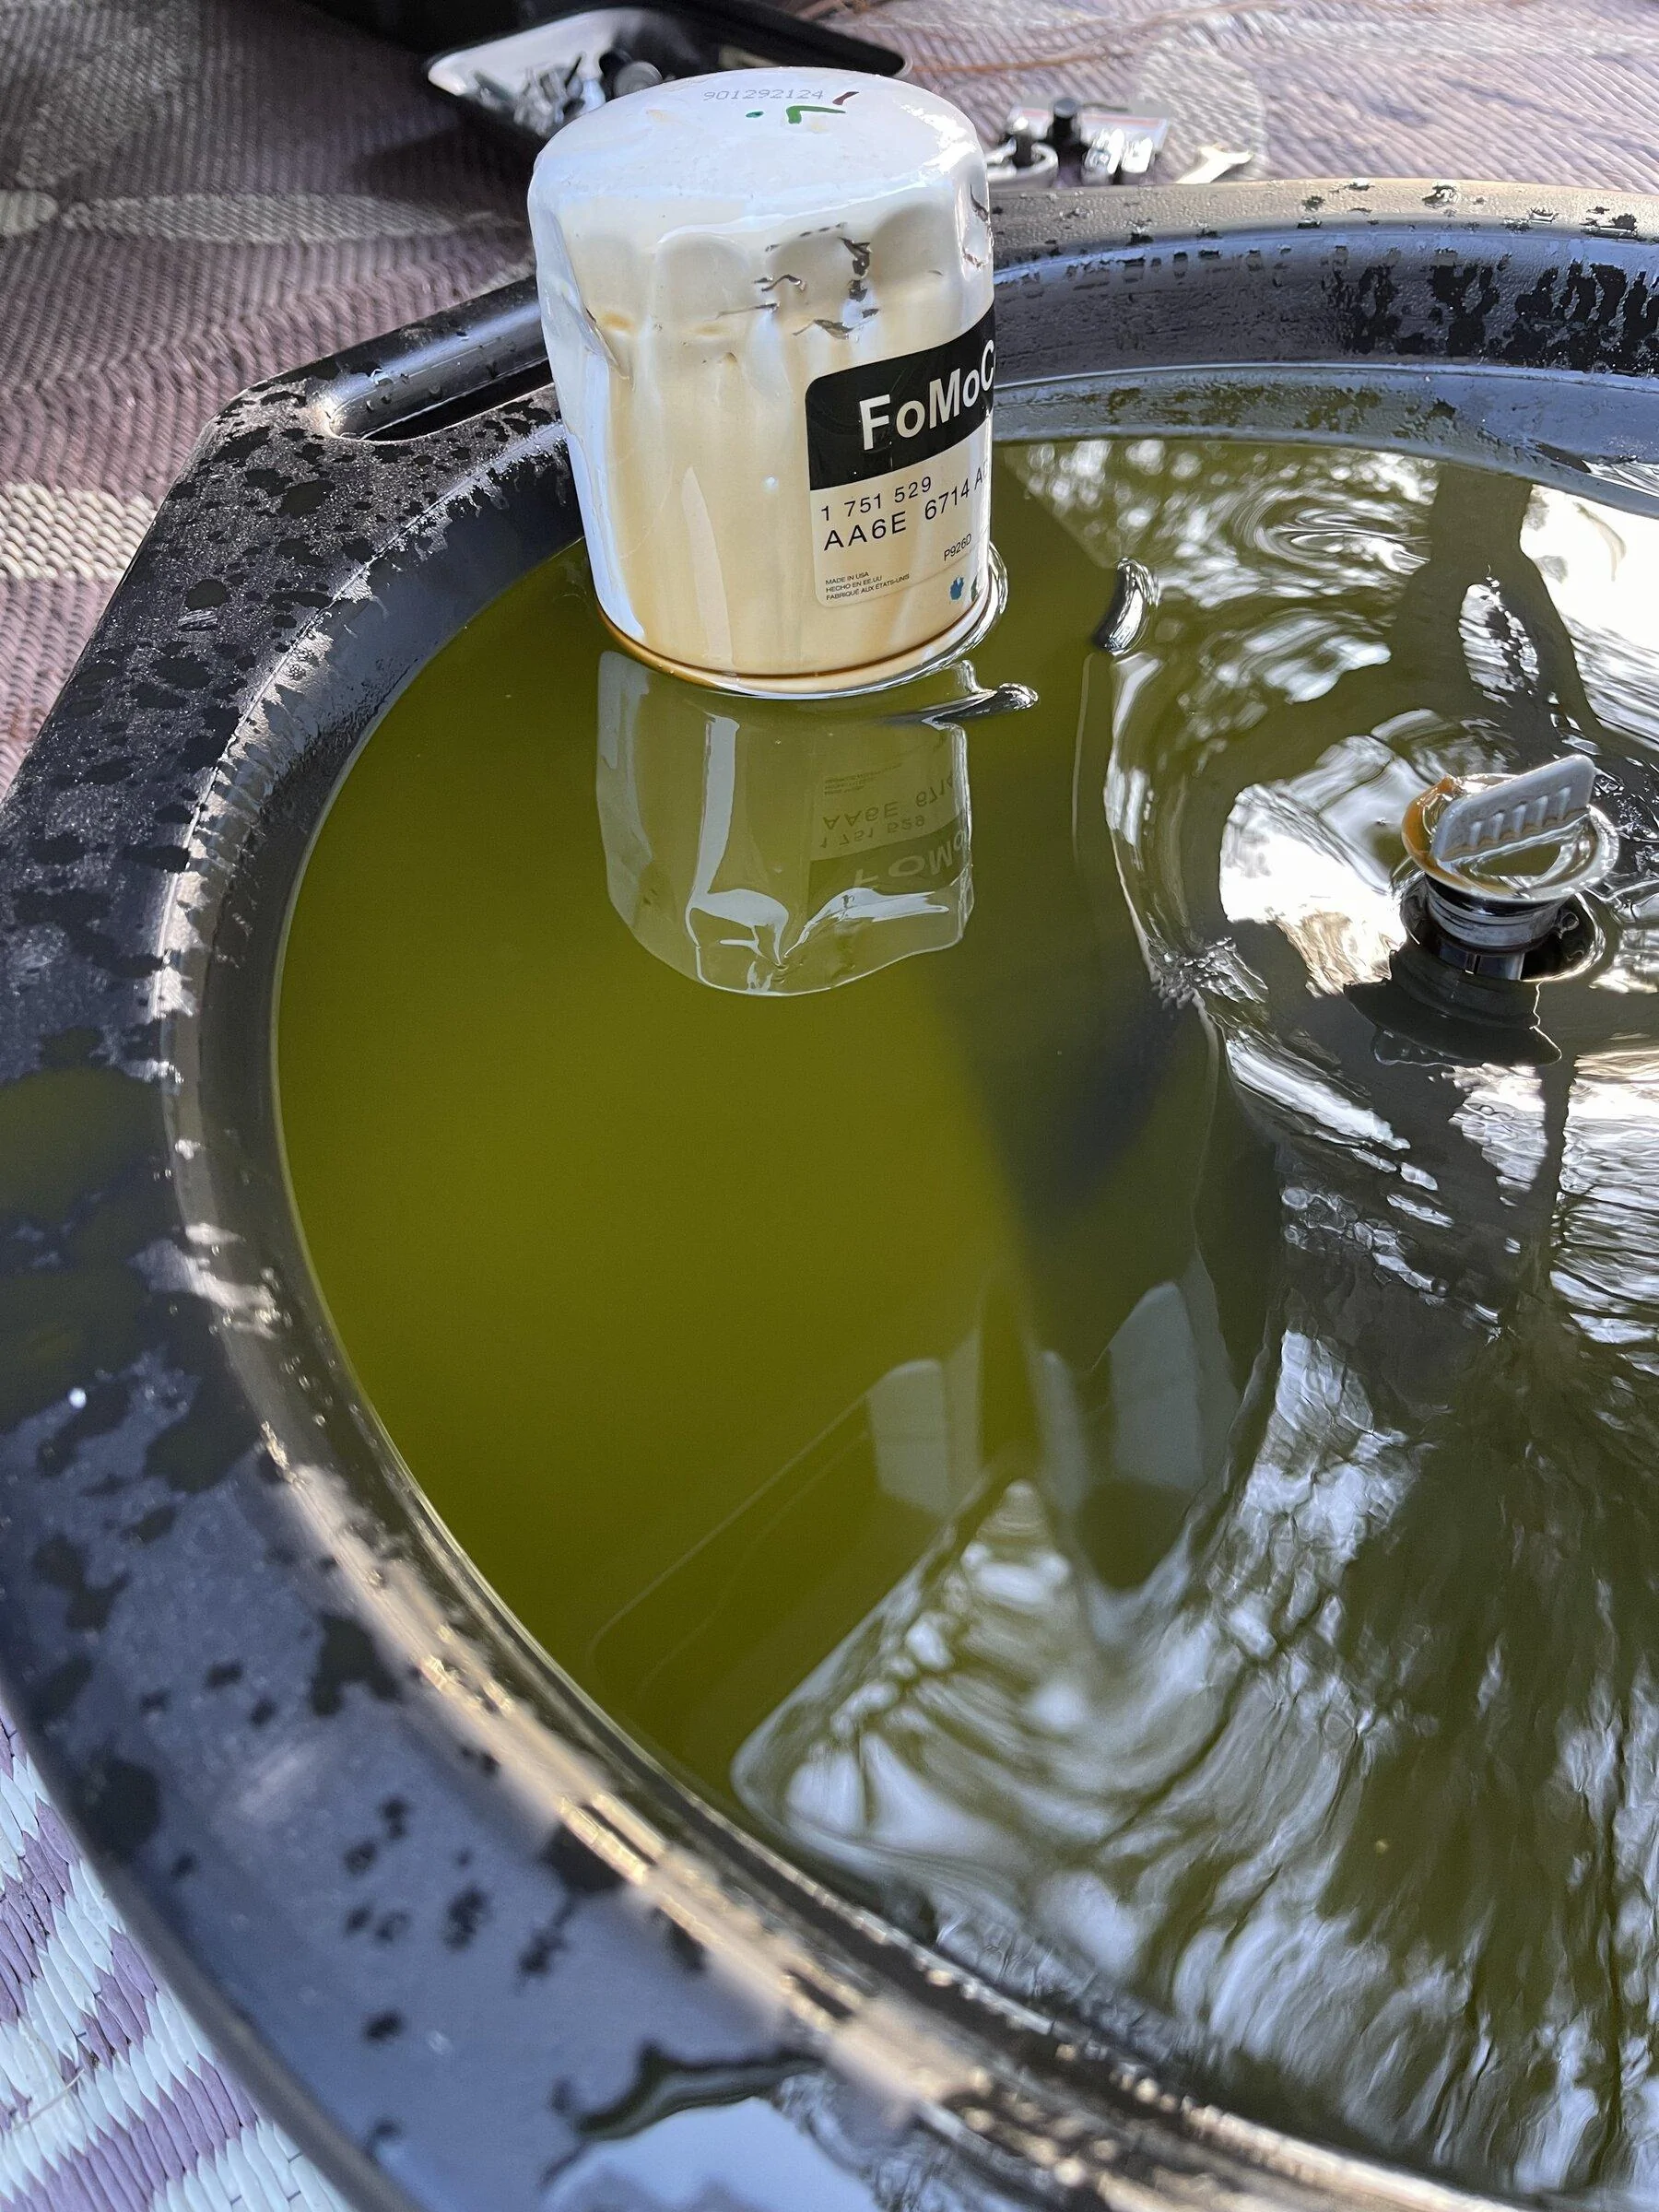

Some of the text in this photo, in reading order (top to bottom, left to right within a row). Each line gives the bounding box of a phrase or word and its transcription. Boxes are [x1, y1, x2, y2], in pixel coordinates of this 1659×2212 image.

[703, 88, 824, 101] 901292124
[821, 477, 932, 522] 1 751 529
[824, 511, 906, 551] AA6E
[924, 477, 970, 520] 6714
[825, 576, 846, 585] MADE
[826, 583, 851, 593] HECHO
[852, 580, 862, 588] EN
[861, 584, 875, 594] AUX
